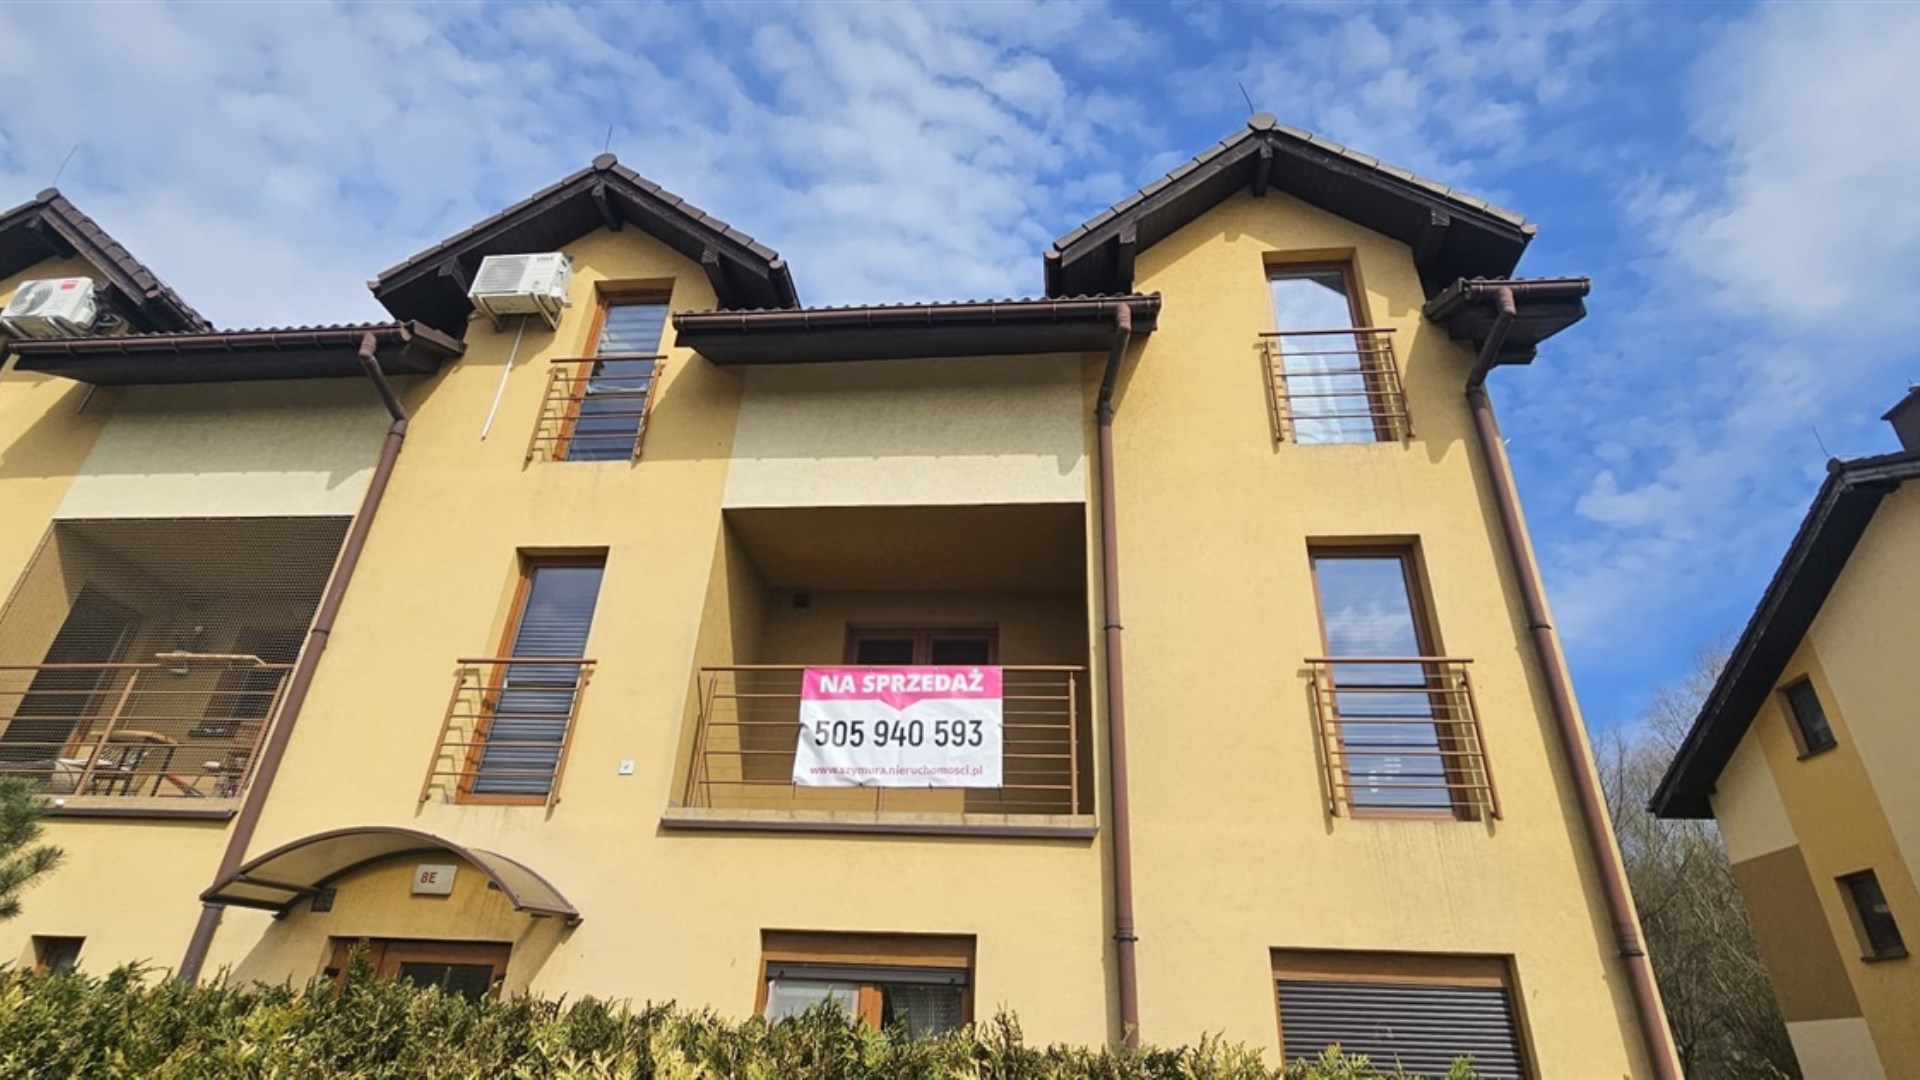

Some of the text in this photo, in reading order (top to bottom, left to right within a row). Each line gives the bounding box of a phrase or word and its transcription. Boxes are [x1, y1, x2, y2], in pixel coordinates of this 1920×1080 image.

[819, 669, 984, 693] NA SPRZEDAŻ
[814, 720, 983, 747] 505 940 593
[810, 764, 983, 777] www.szymura.nieruchomosci.pl
[420, 872, 438, 883] 8E
